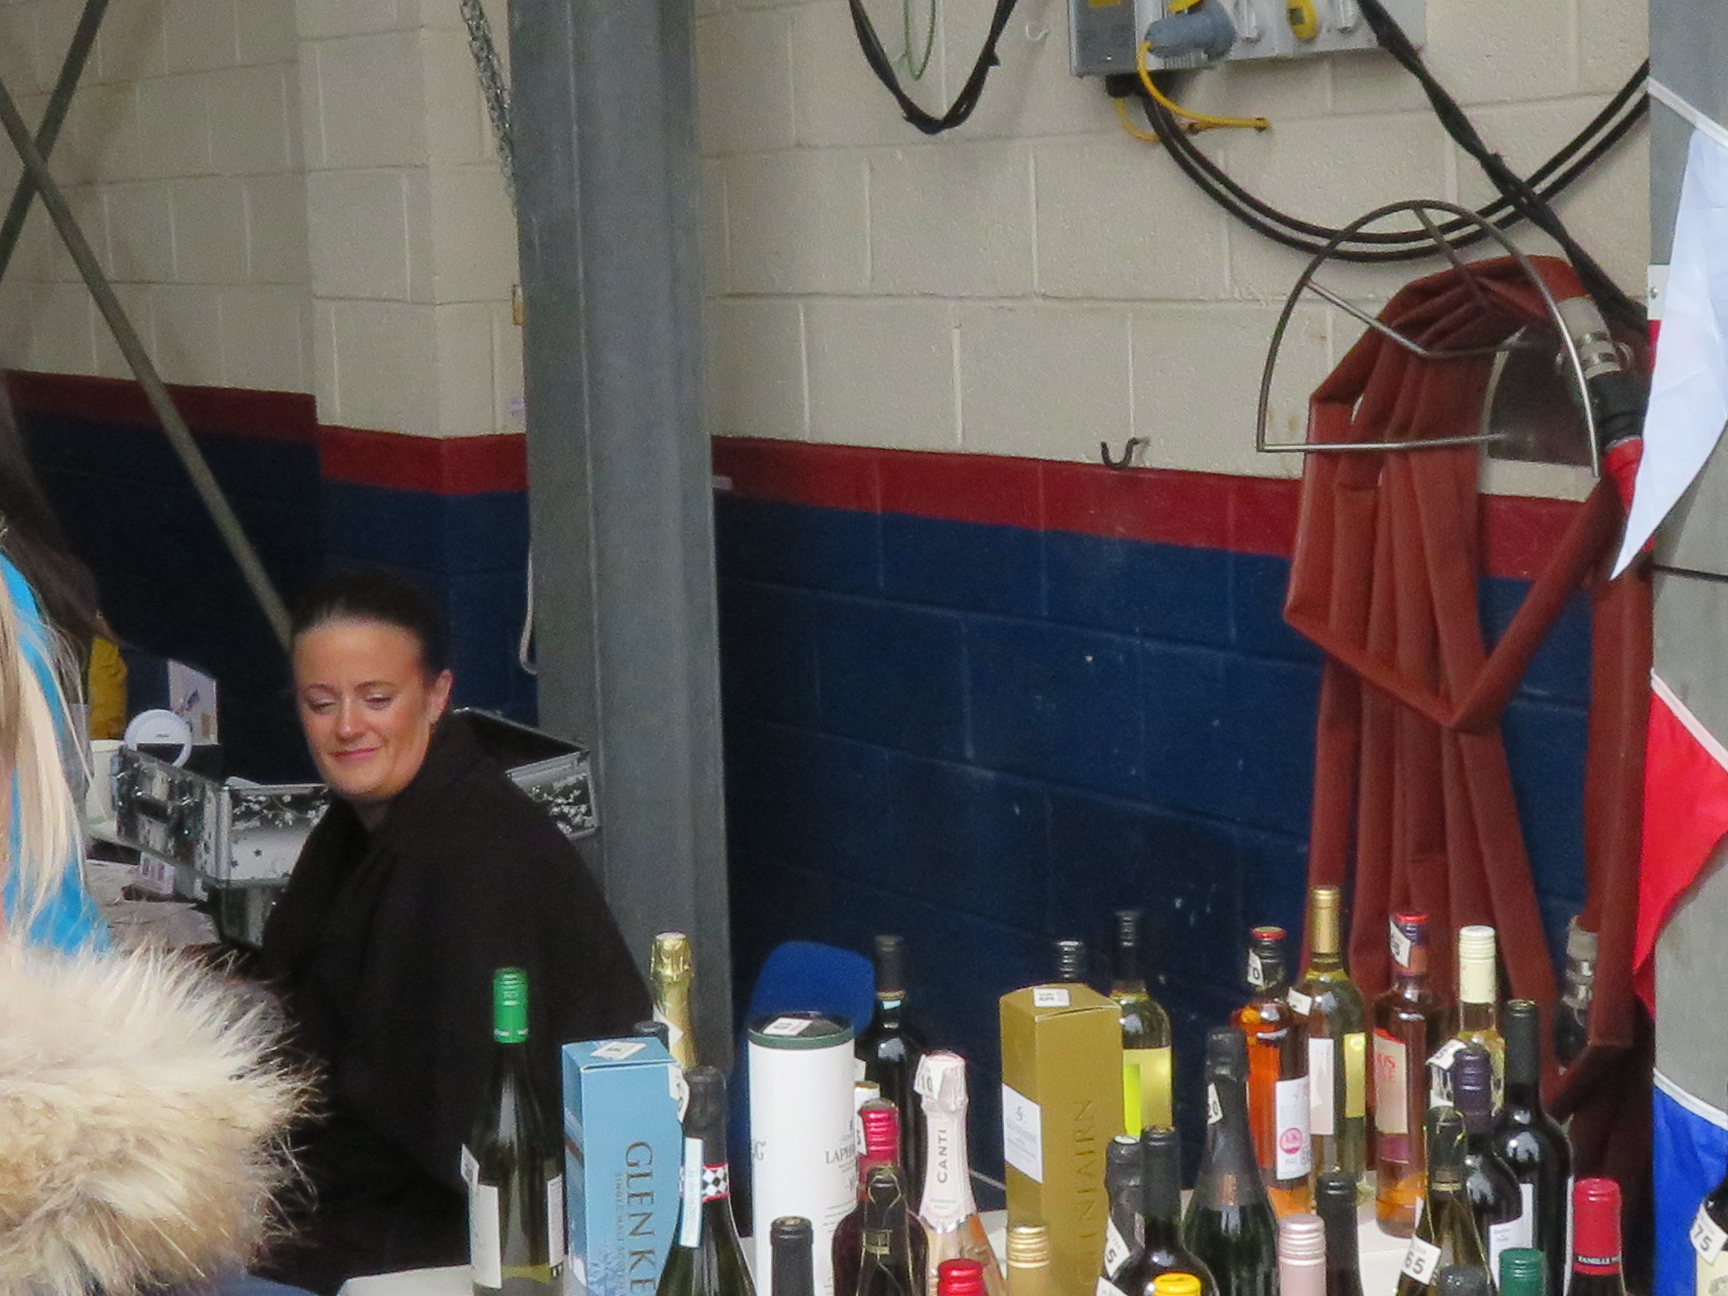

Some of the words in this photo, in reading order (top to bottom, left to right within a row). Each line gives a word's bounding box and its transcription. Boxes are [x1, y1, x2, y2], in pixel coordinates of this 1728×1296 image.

[937, 1129, 948, 1183] CANTI
[625, 1141, 656, 1237] GLEN
[1692, 1223, 1713, 1252] 75
